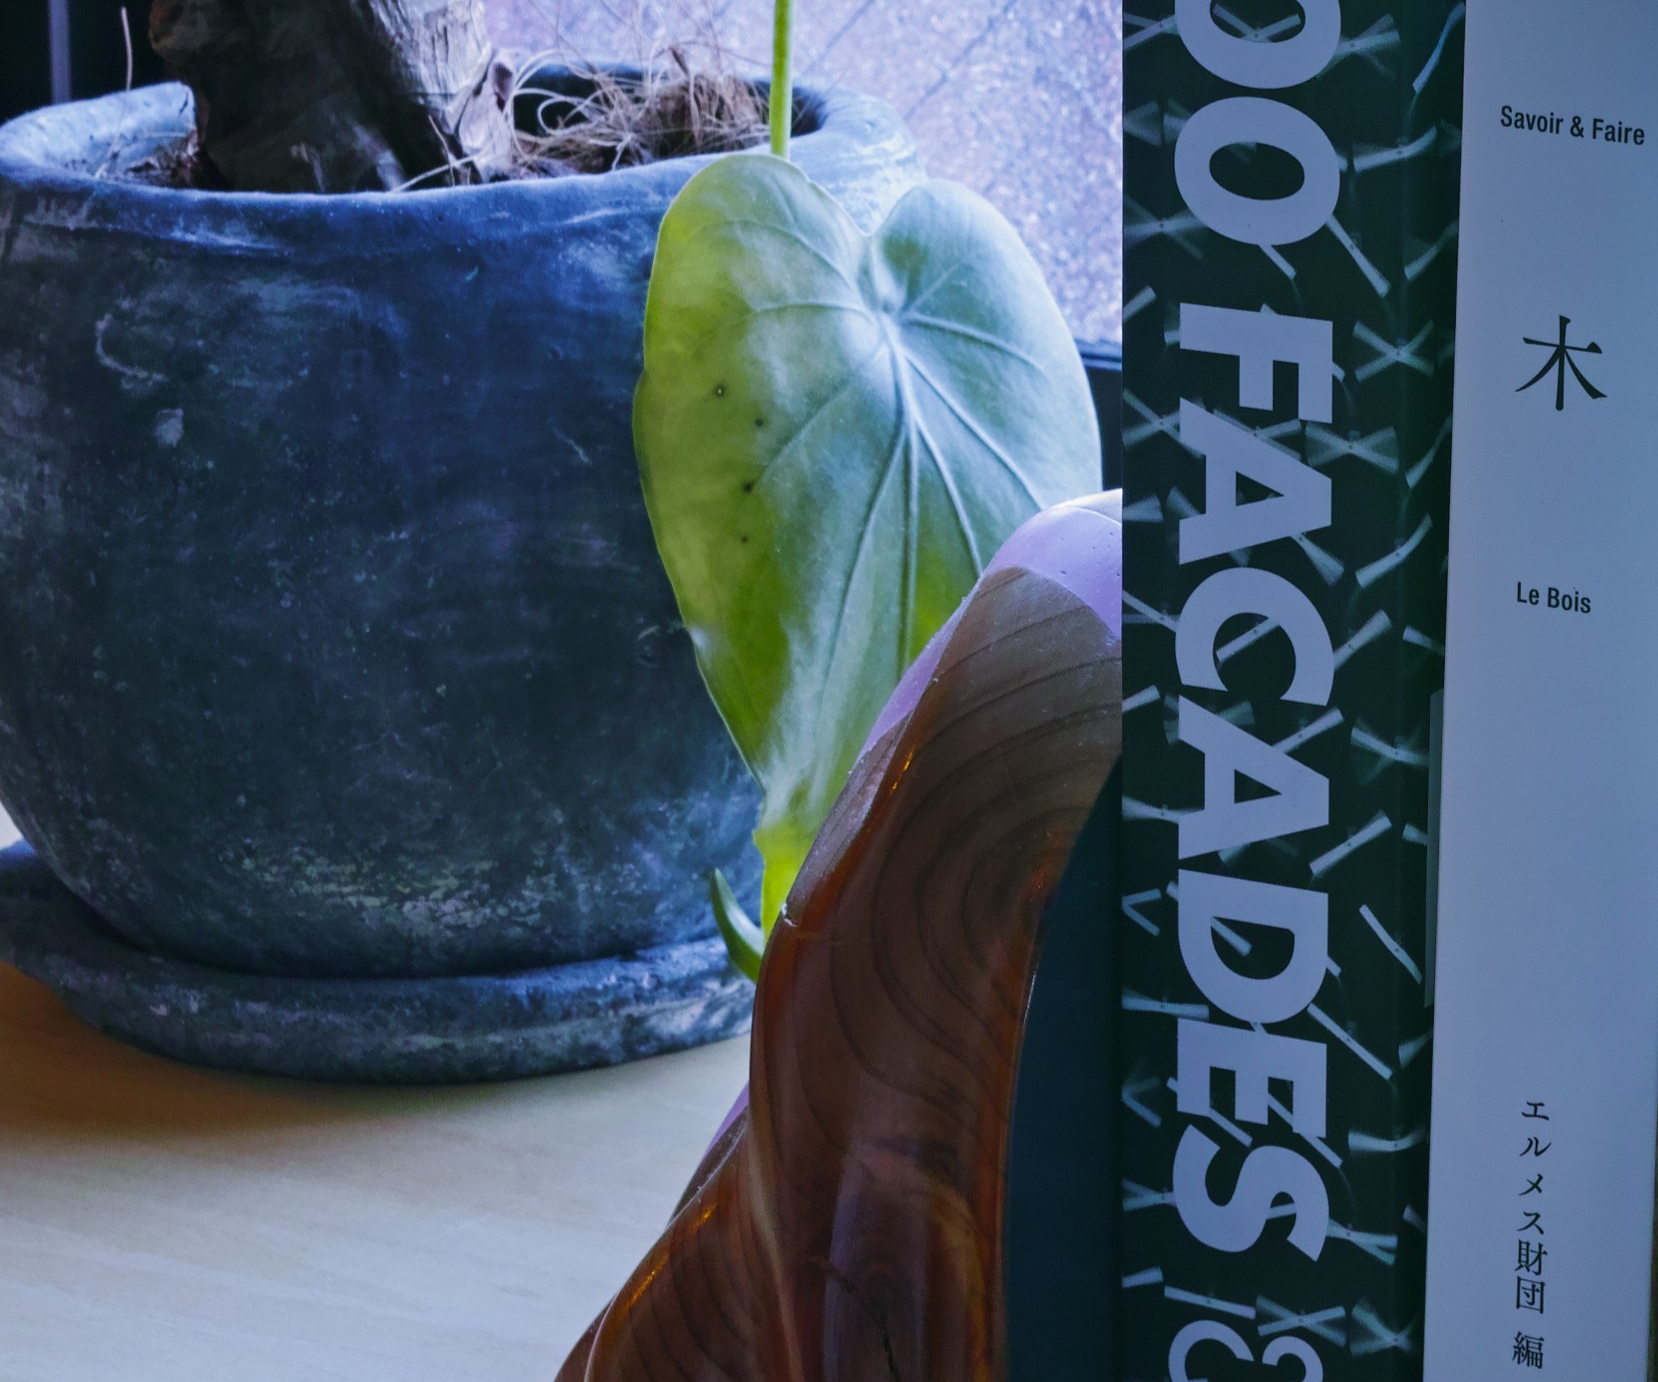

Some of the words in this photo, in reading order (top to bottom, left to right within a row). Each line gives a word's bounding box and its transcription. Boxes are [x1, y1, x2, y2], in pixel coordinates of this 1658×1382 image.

[1500, 105, 1564, 139] Savoir
[1570, 115, 1585, 139] &
[1591, 117, 1646, 146] Faire
[1514, 315, 1608, 412] 木
[1516, 582, 1545, 607] Le
[1547, 585, 1592, 615] Bois
[1172, 303, 1335, 1262] FACADES
[1513, 1100, 1552, 1315] エルメス財団
[1511, 1331, 1545, 1370] 編
